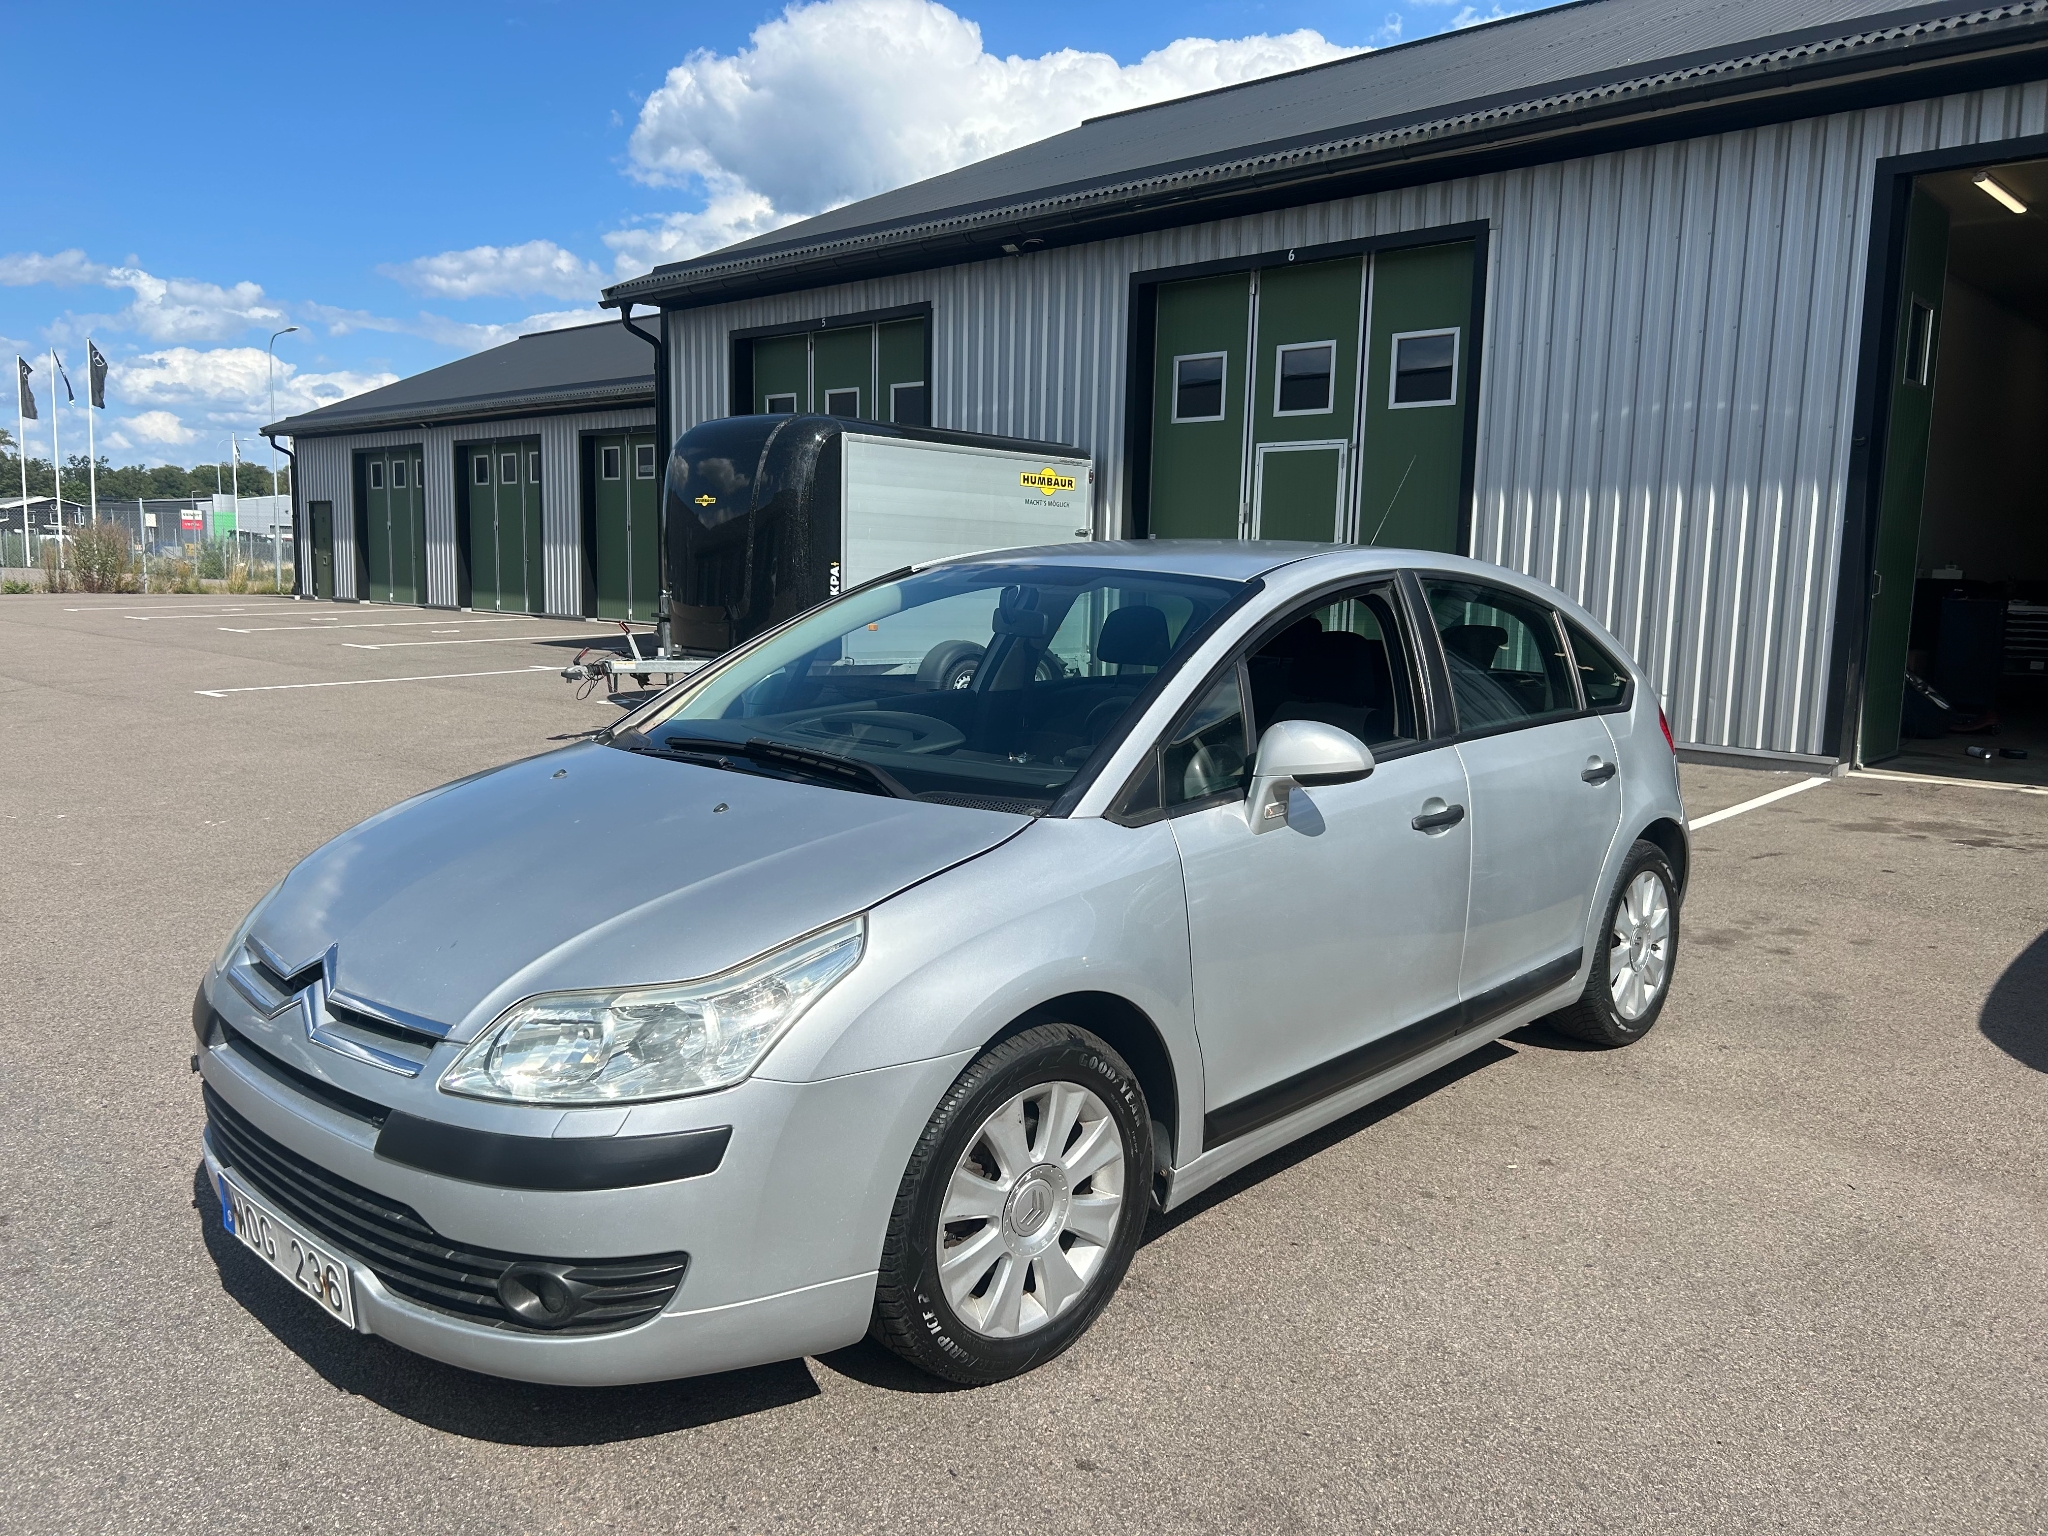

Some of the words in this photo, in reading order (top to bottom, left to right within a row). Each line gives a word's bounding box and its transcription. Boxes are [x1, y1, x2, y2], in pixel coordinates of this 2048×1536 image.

[1288, 249, 1295, 261] 6
[821, 317, 826, 328] 5
[1022, 475, 1074, 489] HUMBAUR
[227, 1210, 233, 1222] S
[291, 1237, 345, 1313] 236
[917, 1292, 931, 1304] 2
[921, 1308, 942, 1336] ICE
